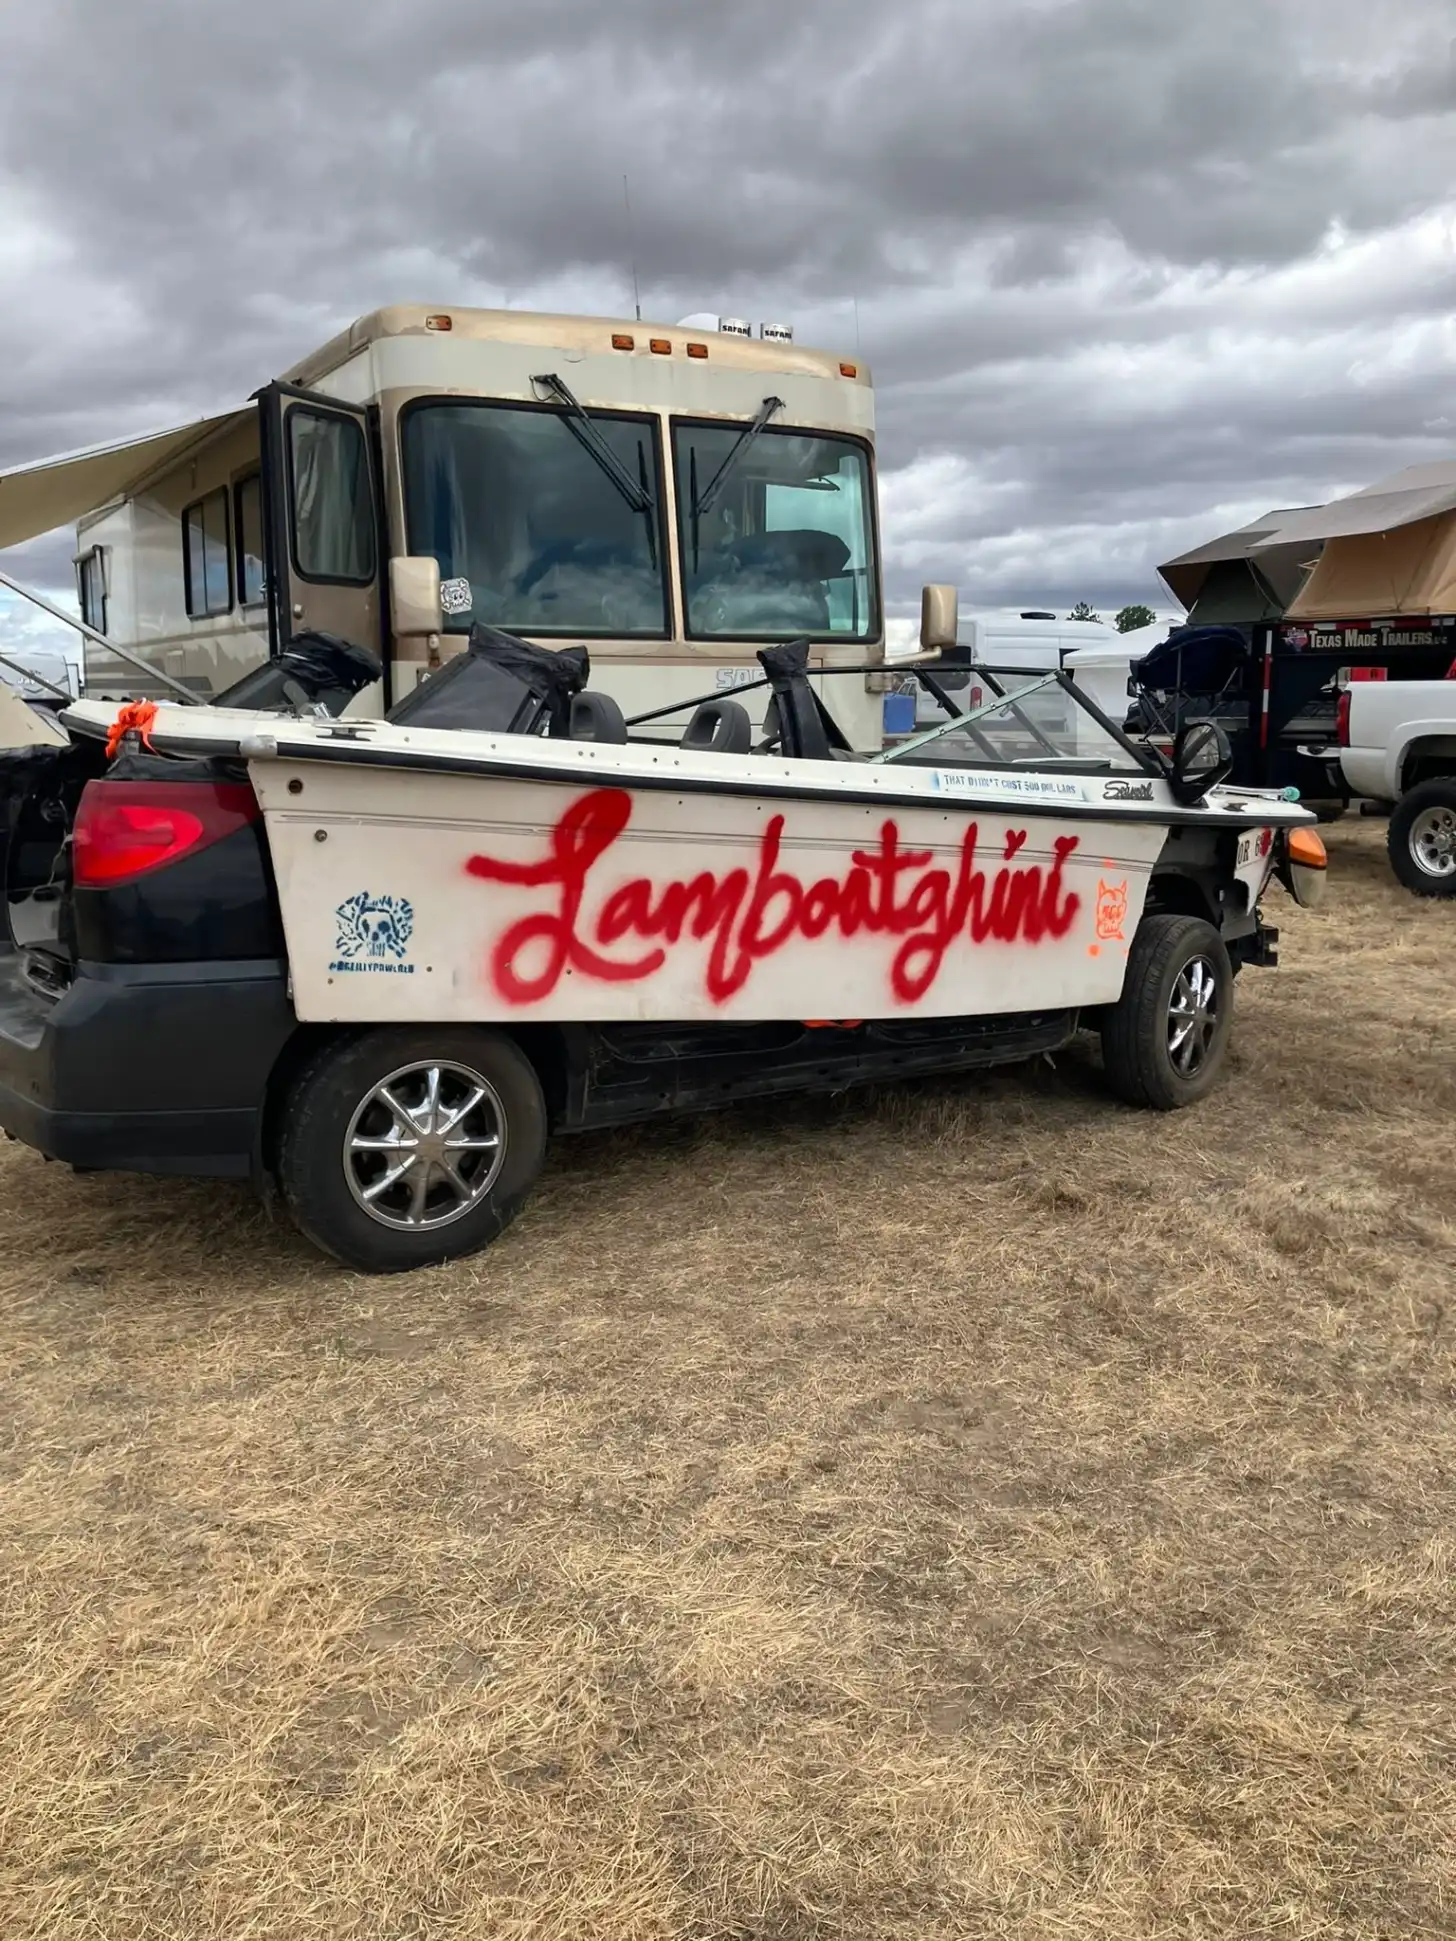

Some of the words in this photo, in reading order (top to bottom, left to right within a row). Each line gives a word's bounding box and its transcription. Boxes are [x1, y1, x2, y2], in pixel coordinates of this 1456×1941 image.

[1309, 630, 1342, 648] TEXAS
[1344, 629, 1378, 647] MADE
[943, 774, 965, 785] THAT
[467, 788, 1079, 1004] Lamboatghini
